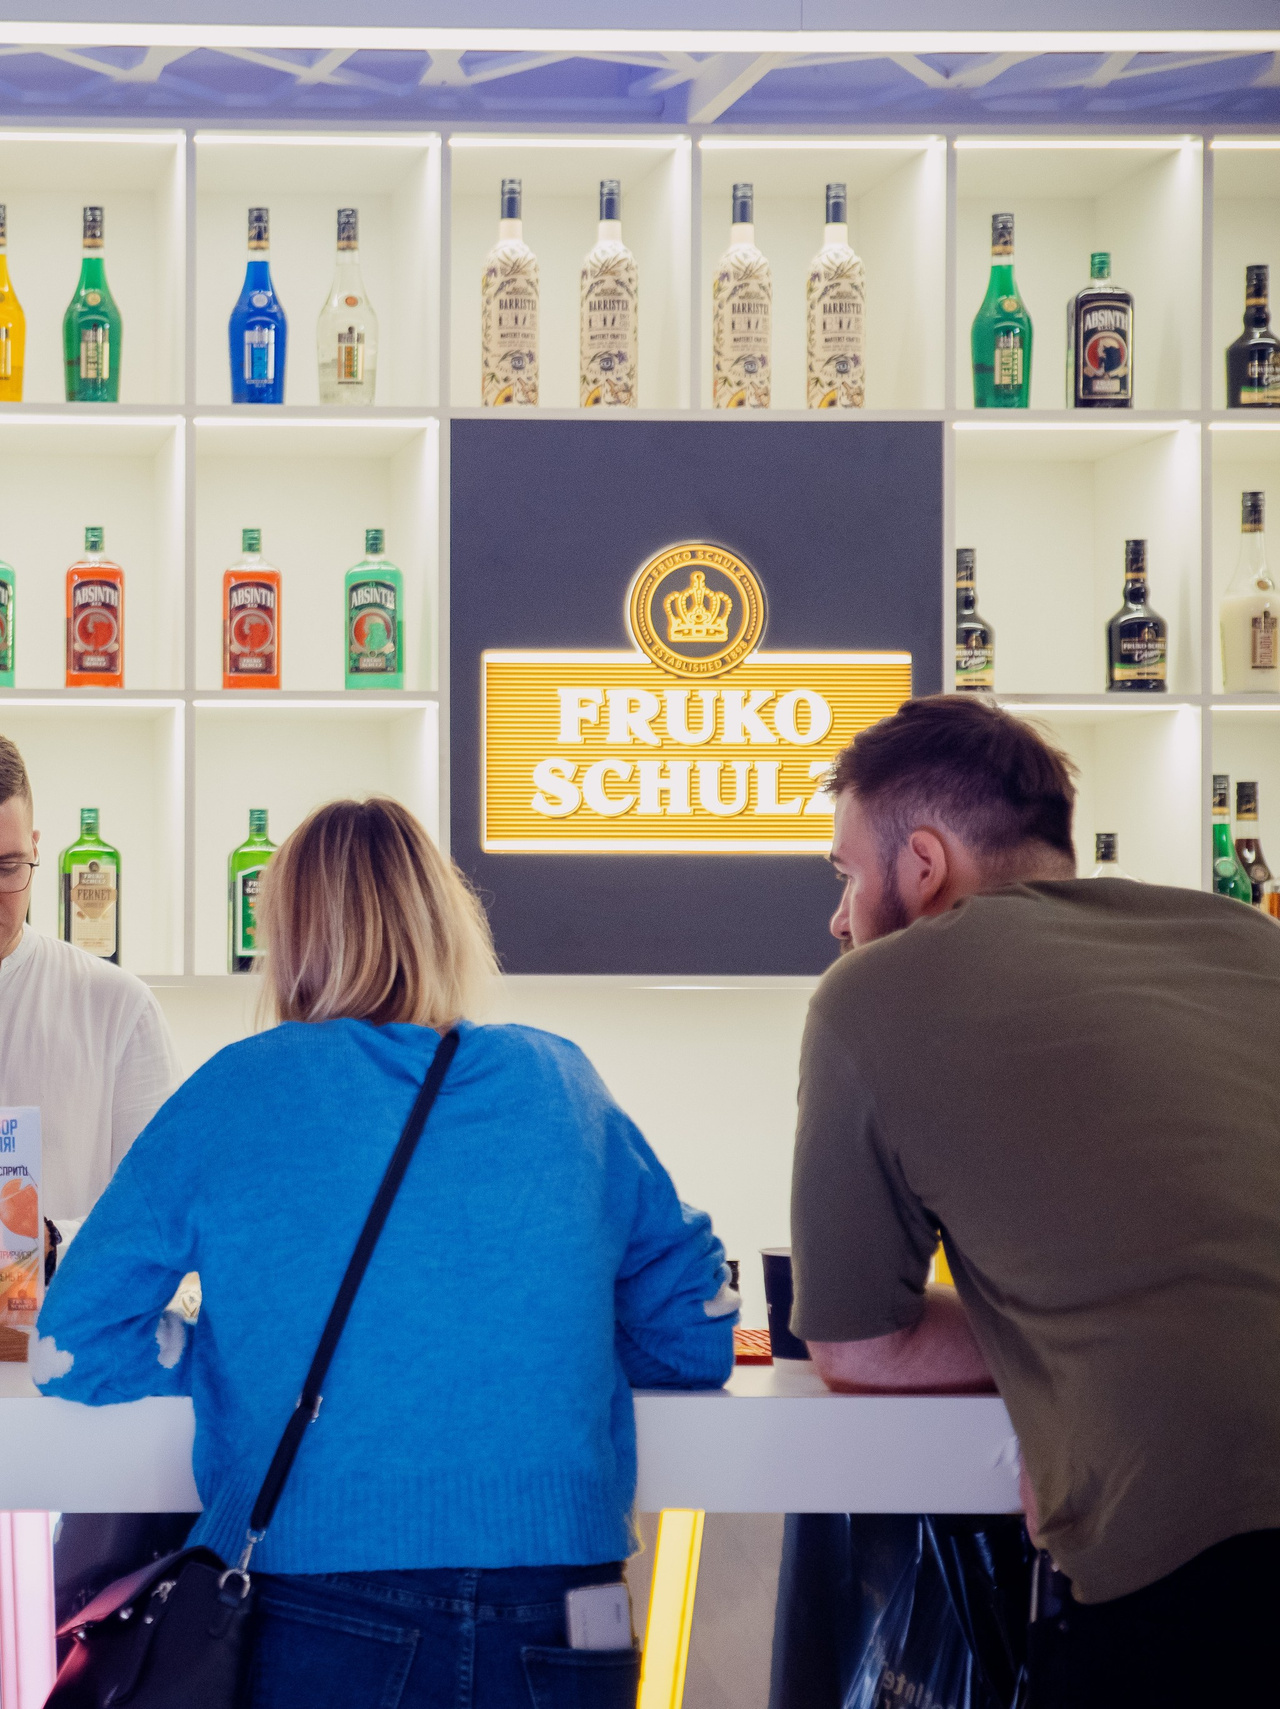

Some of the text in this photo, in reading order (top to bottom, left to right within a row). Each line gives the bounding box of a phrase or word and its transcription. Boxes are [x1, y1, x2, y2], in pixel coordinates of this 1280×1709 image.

[1085, 309, 1128, 331] ABSINTH
[650, 551, 745, 581] FRUKO SCHULZ
[74, 587, 118, 607] ABSINTH
[231, 587, 275, 608] ABSINTH
[351, 587, 395, 609] ABSINTH
[652, 640, 749, 673] ESTABLISHED 1898
[557, 688, 834, 747] FRUKO
[77, 888, 111, 901] FERNET
